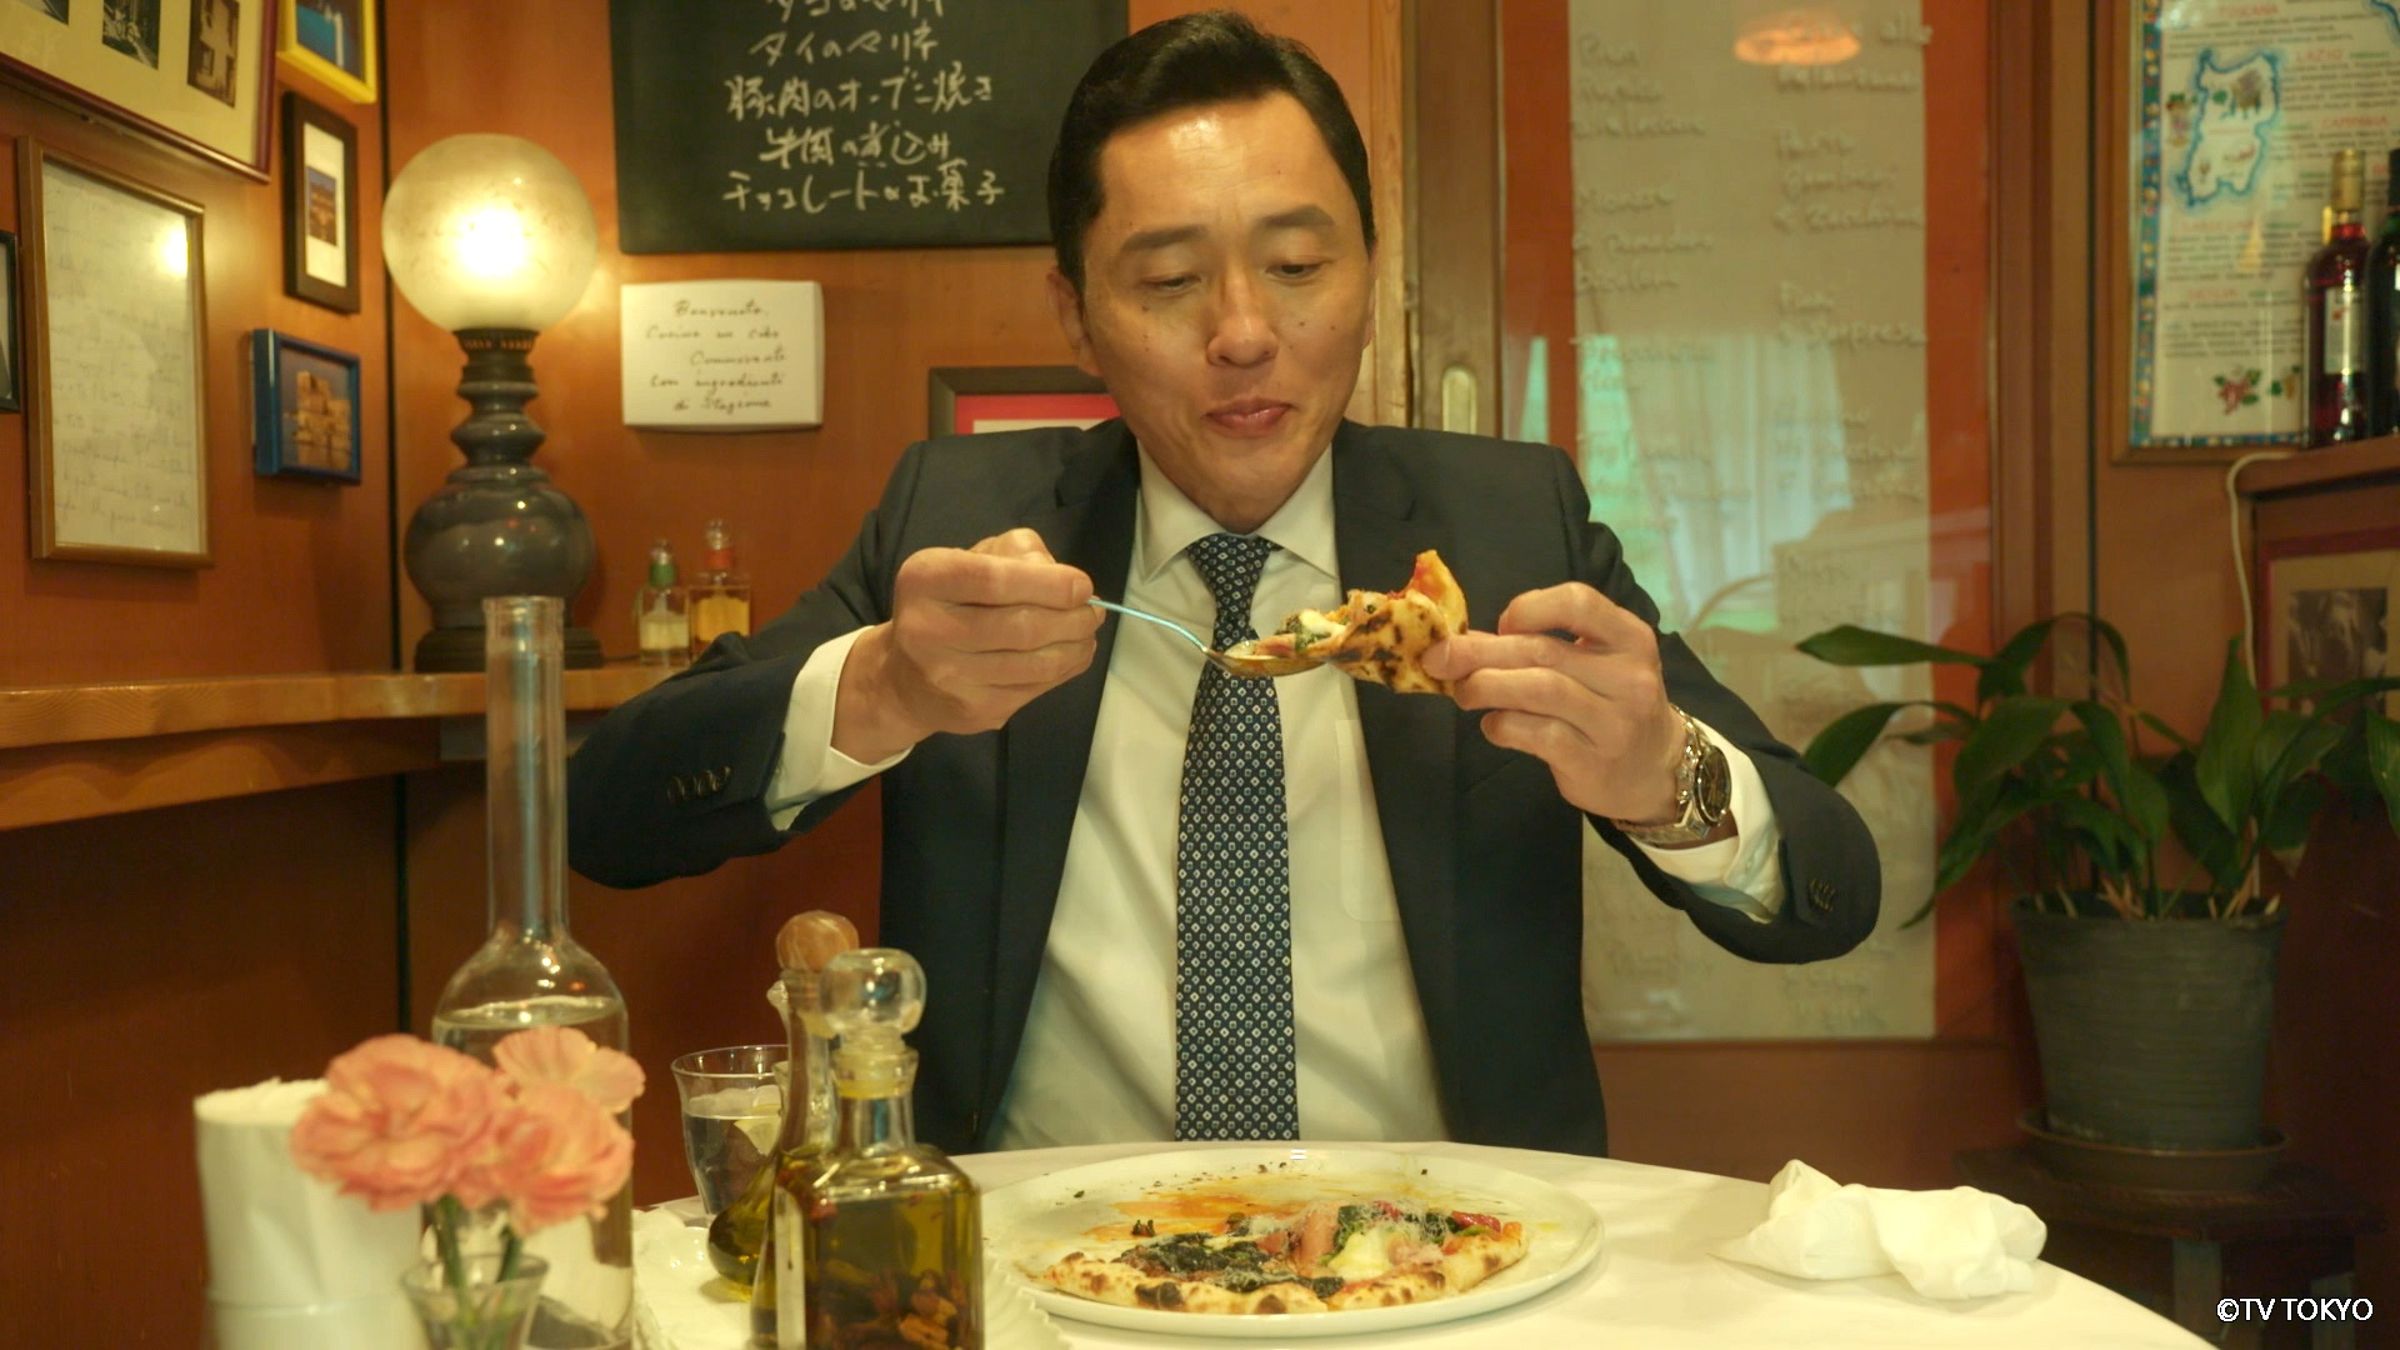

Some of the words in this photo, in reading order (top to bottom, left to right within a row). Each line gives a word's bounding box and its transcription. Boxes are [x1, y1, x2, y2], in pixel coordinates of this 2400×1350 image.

[749, 19, 939, 67] タイのマリネ
[724, 61, 992, 121] 豚肉のオーブン焼き
